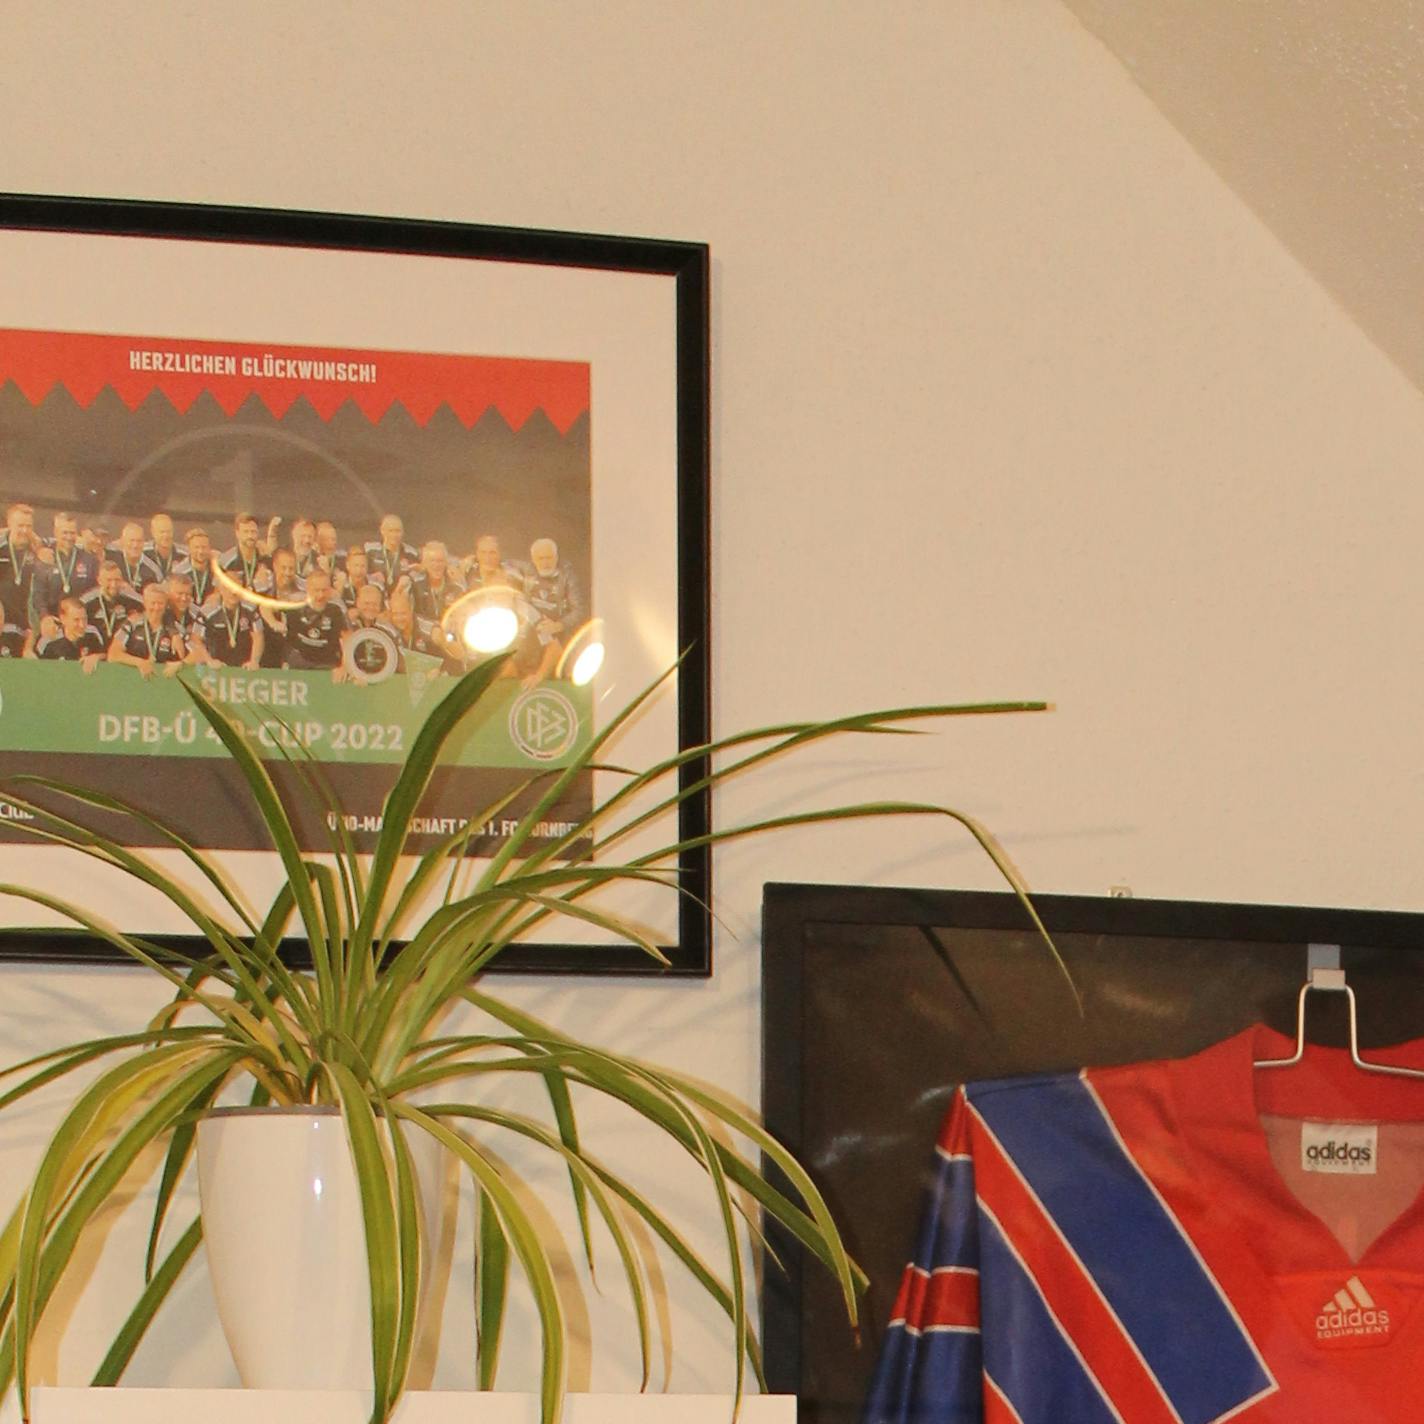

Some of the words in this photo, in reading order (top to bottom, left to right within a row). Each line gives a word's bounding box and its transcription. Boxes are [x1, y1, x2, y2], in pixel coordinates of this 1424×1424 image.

[129, 350, 236, 376] HERZLICHEN
[241, 353, 377, 384] GLÜCKWUNSCH!
[201, 676, 308, 706] SIEGER
[99, 711, 197, 744] DFB-Ü
[330, 722, 403, 751] 2022
[1306, 1141, 1371, 1161] adidas
[1315, 1308, 1390, 1330] adidas
[1316, 1325, 1390, 1339] EQUIPMENT
